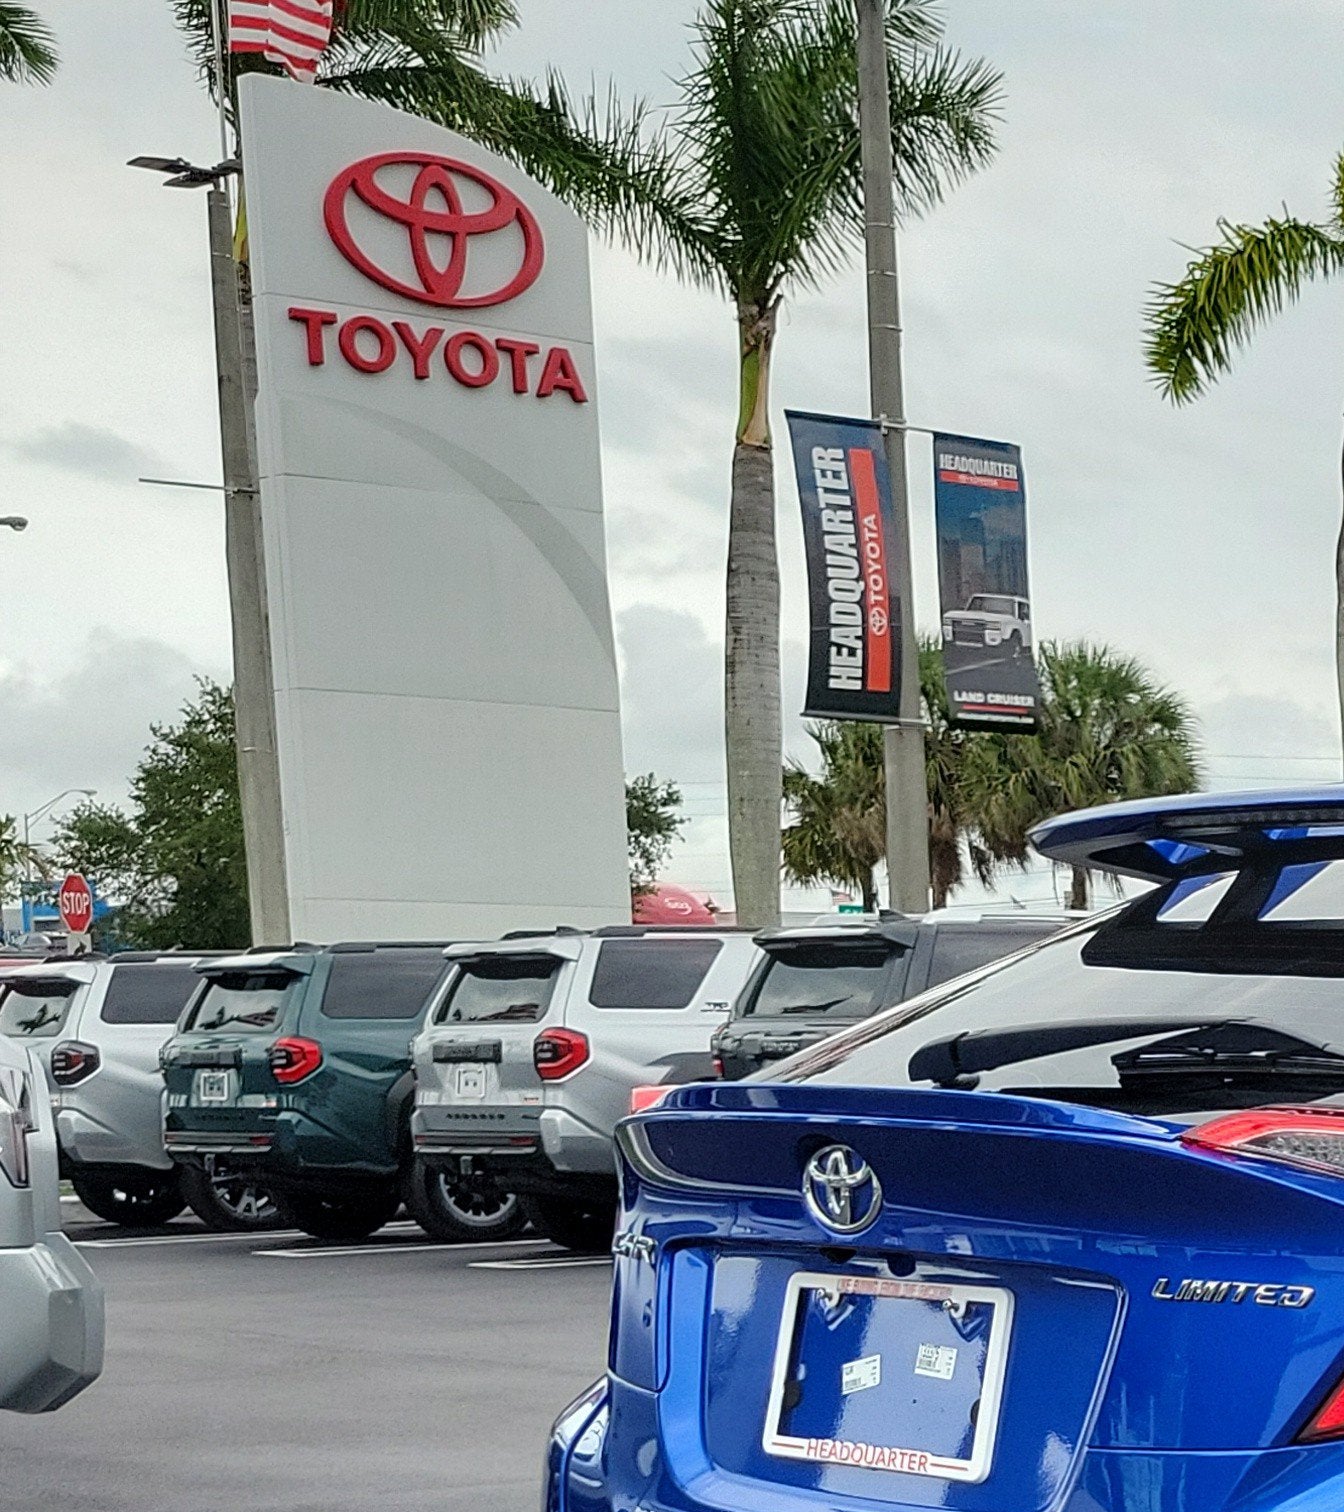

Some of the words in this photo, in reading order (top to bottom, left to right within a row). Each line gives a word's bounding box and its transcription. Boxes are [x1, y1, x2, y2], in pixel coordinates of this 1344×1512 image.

[288, 307, 588, 403] TOYOTA
[939, 453, 1018, 480] HEADQUARTER
[811, 446, 865, 691] HEADQUARTER
[863, 514, 884, 605] TOYOTA
[953, 690, 985, 703] LAND
[63, 892, 90, 915] STOP
[1151, 1278, 1315, 1308] LIMITED
[806, 1440, 929, 1473] HEADQUARTER
